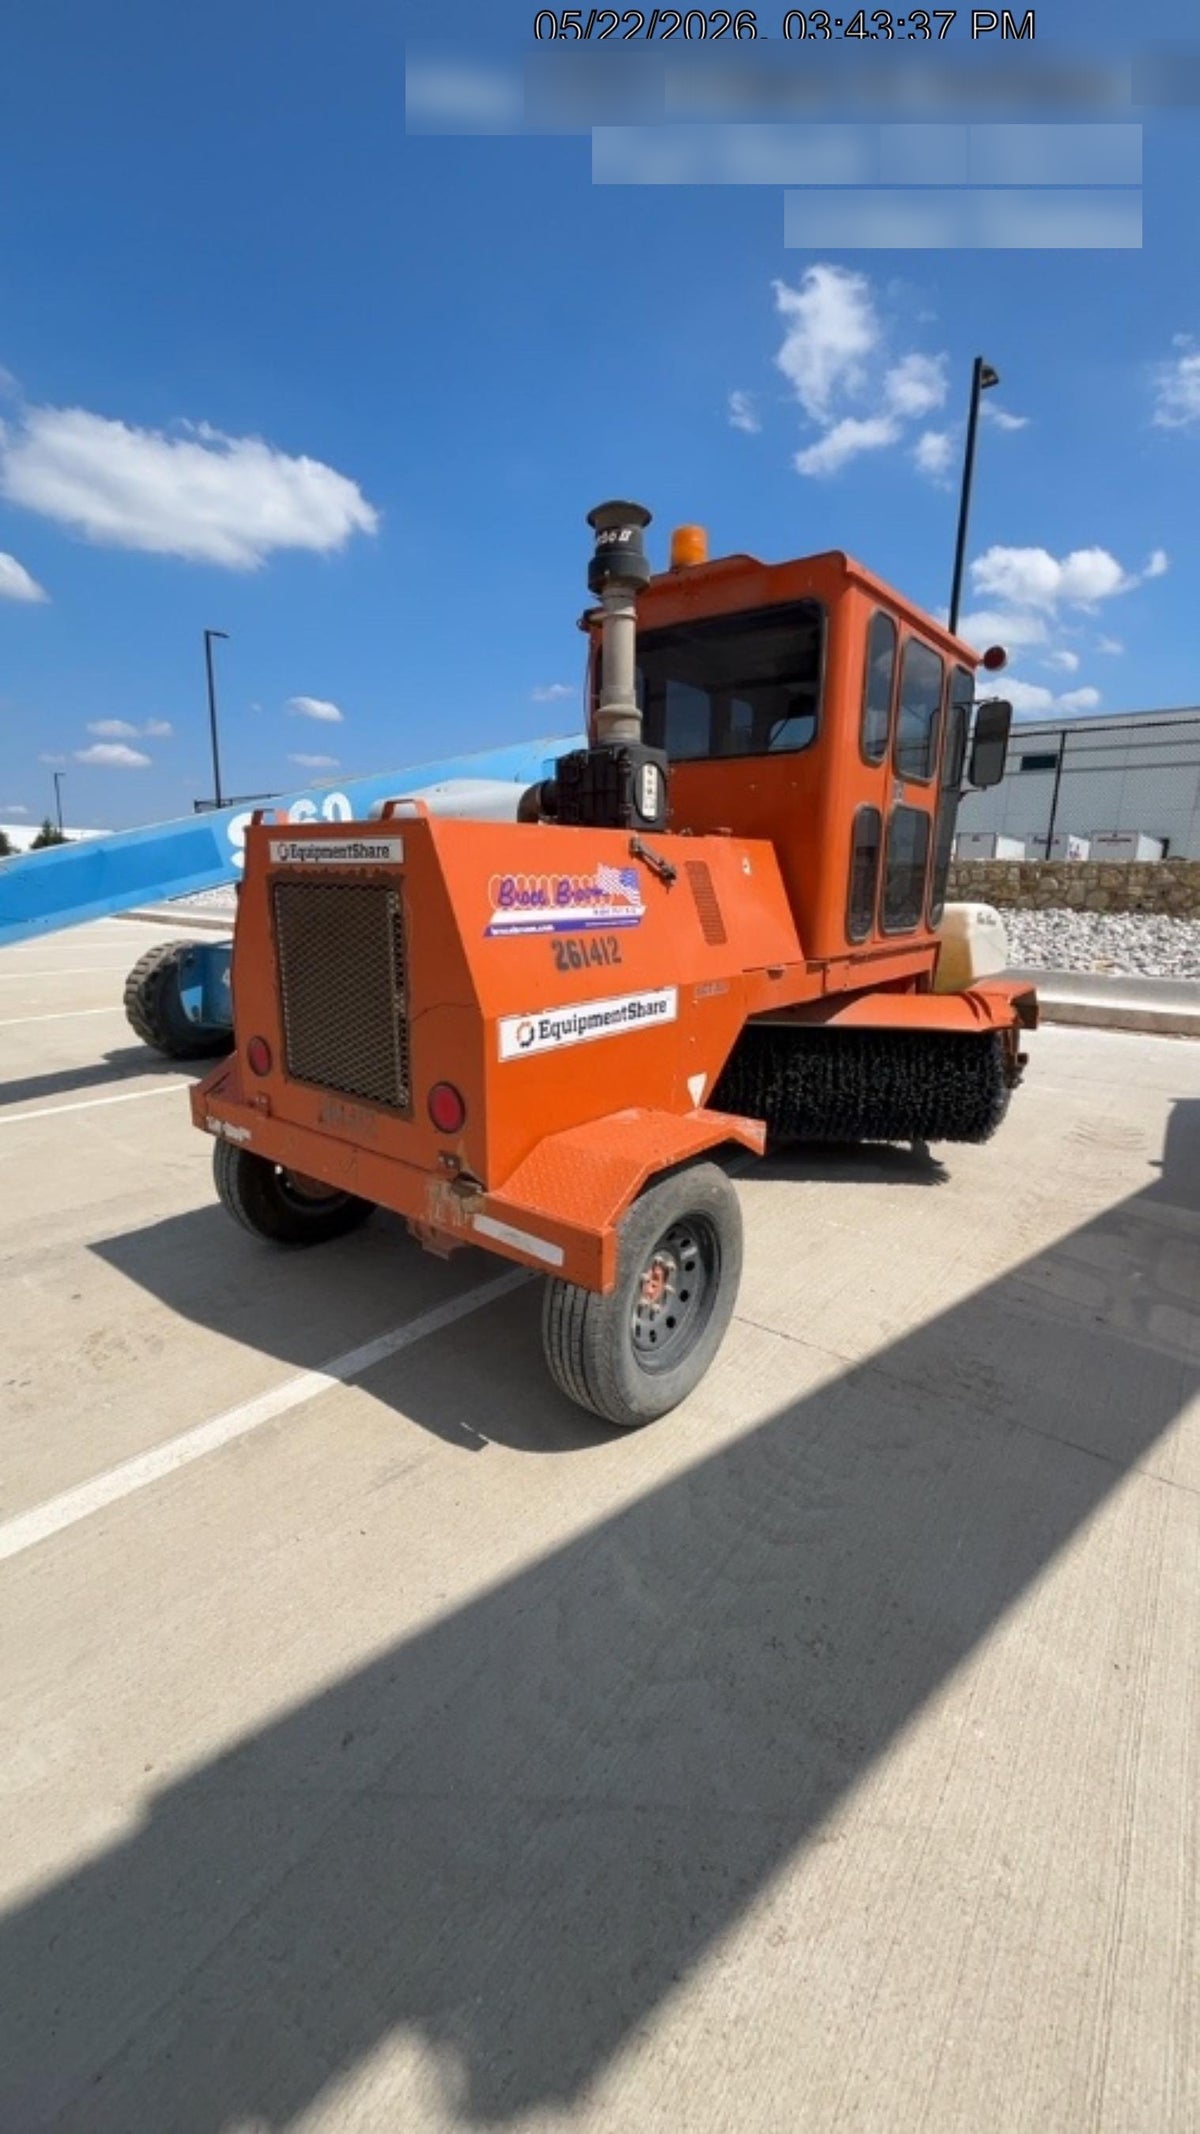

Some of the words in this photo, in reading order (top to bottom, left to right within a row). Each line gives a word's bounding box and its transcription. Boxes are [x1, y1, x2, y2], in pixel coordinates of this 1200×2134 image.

[290, 843, 390, 862] EquipmentShare
[552, 936, 622, 972] 261412
[538, 999, 669, 1041] EquipmentShare
